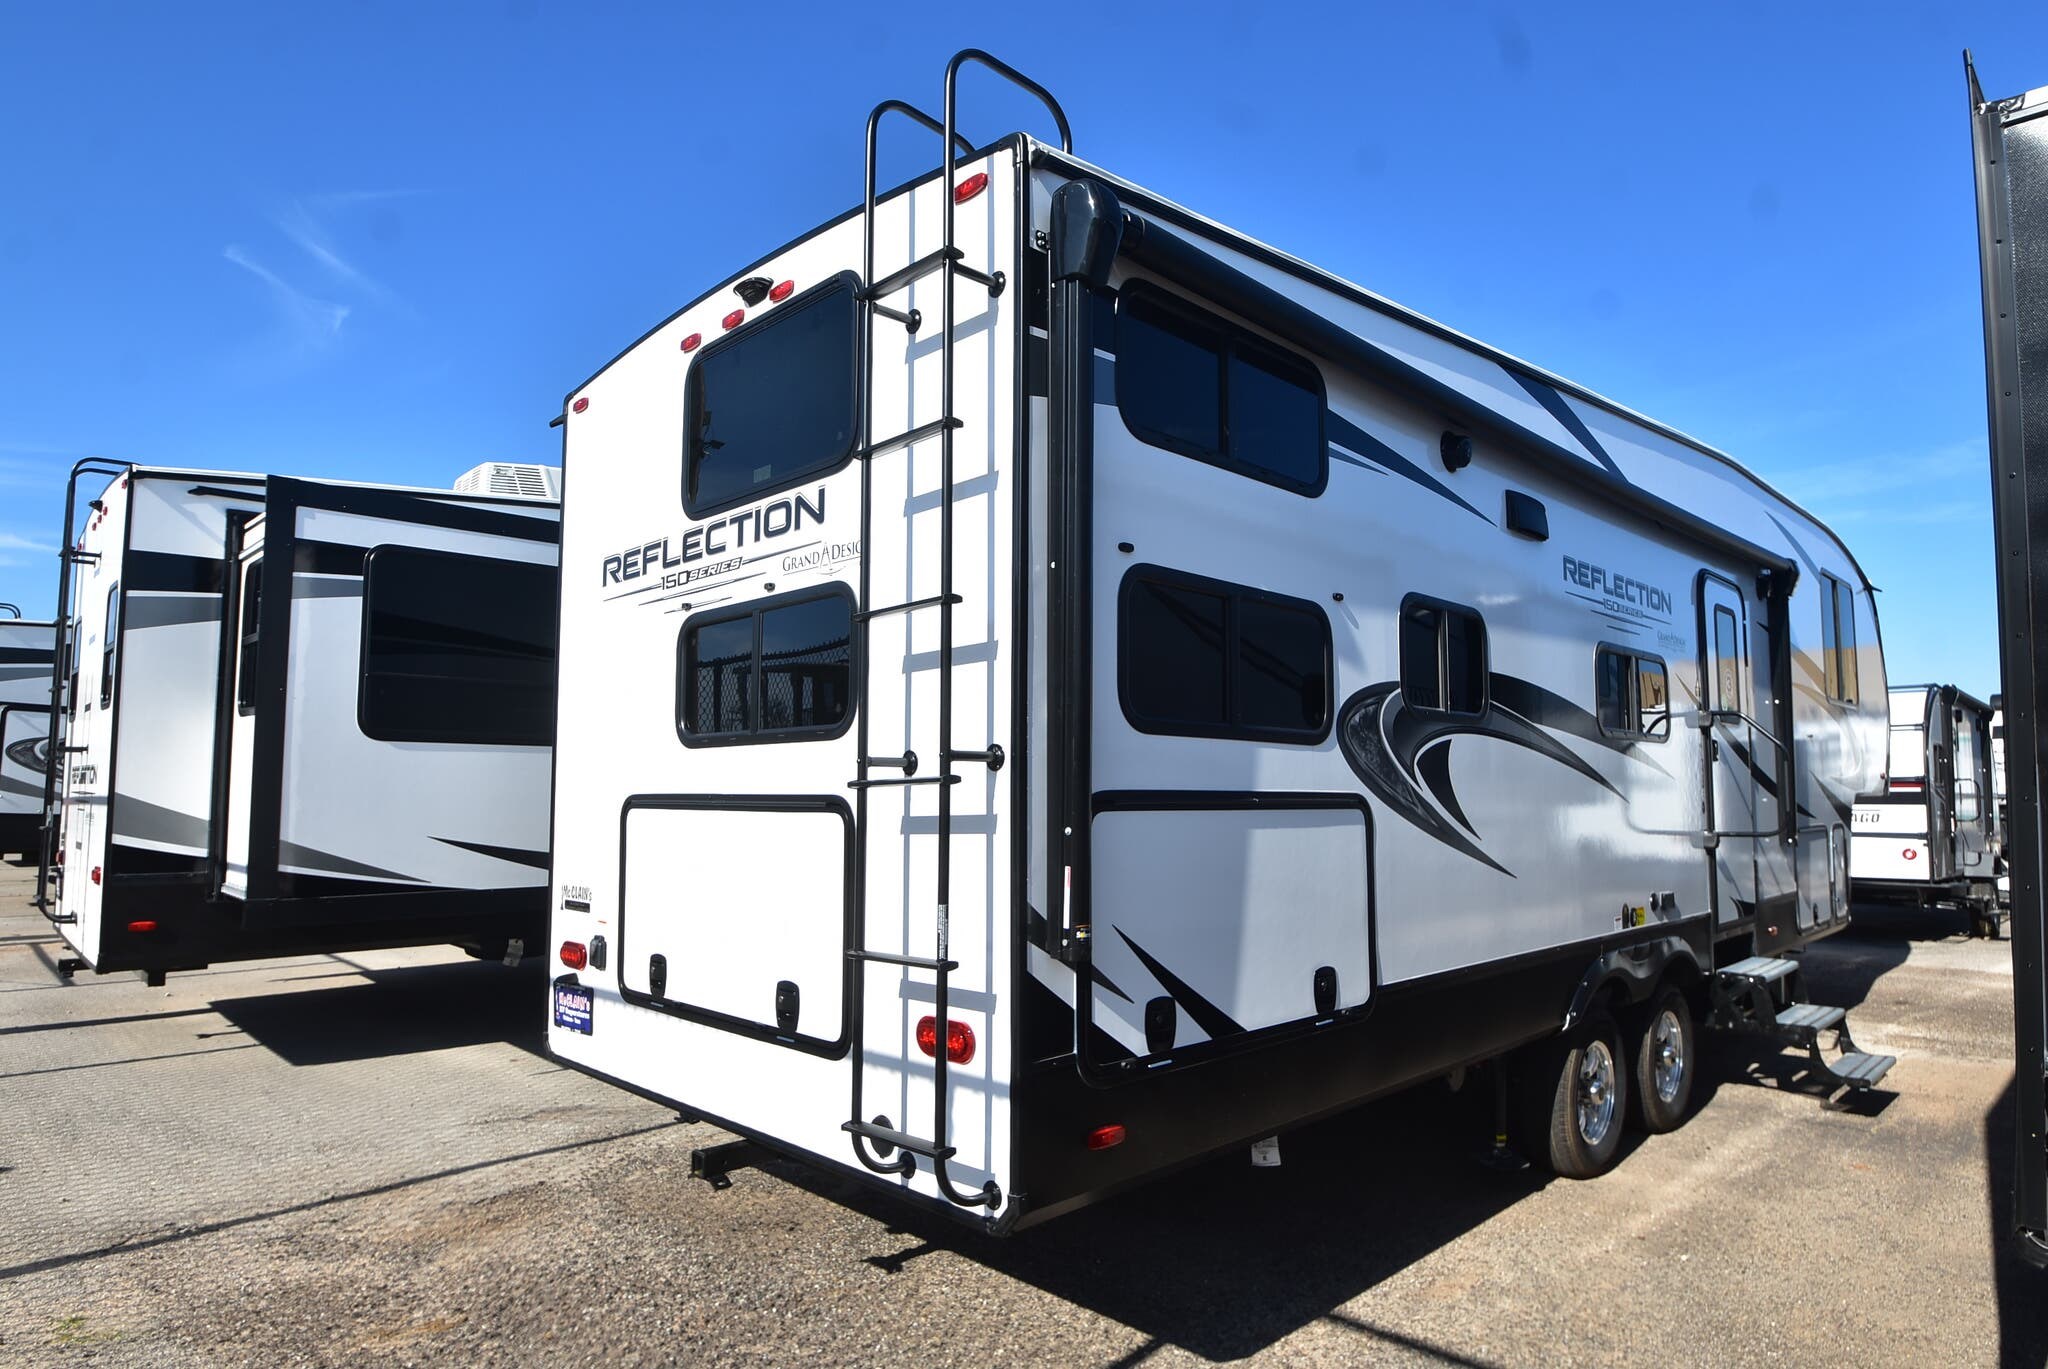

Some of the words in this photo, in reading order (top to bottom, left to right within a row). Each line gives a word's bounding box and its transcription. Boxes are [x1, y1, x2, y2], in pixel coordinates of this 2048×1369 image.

[602, 484, 826, 587] REFLECTION
[661, 569, 689, 590] 150
[688, 557, 743, 582] SERIES
[782, 551, 820, 572] GRAND
[1563, 555, 1672, 615] REFLECTION
